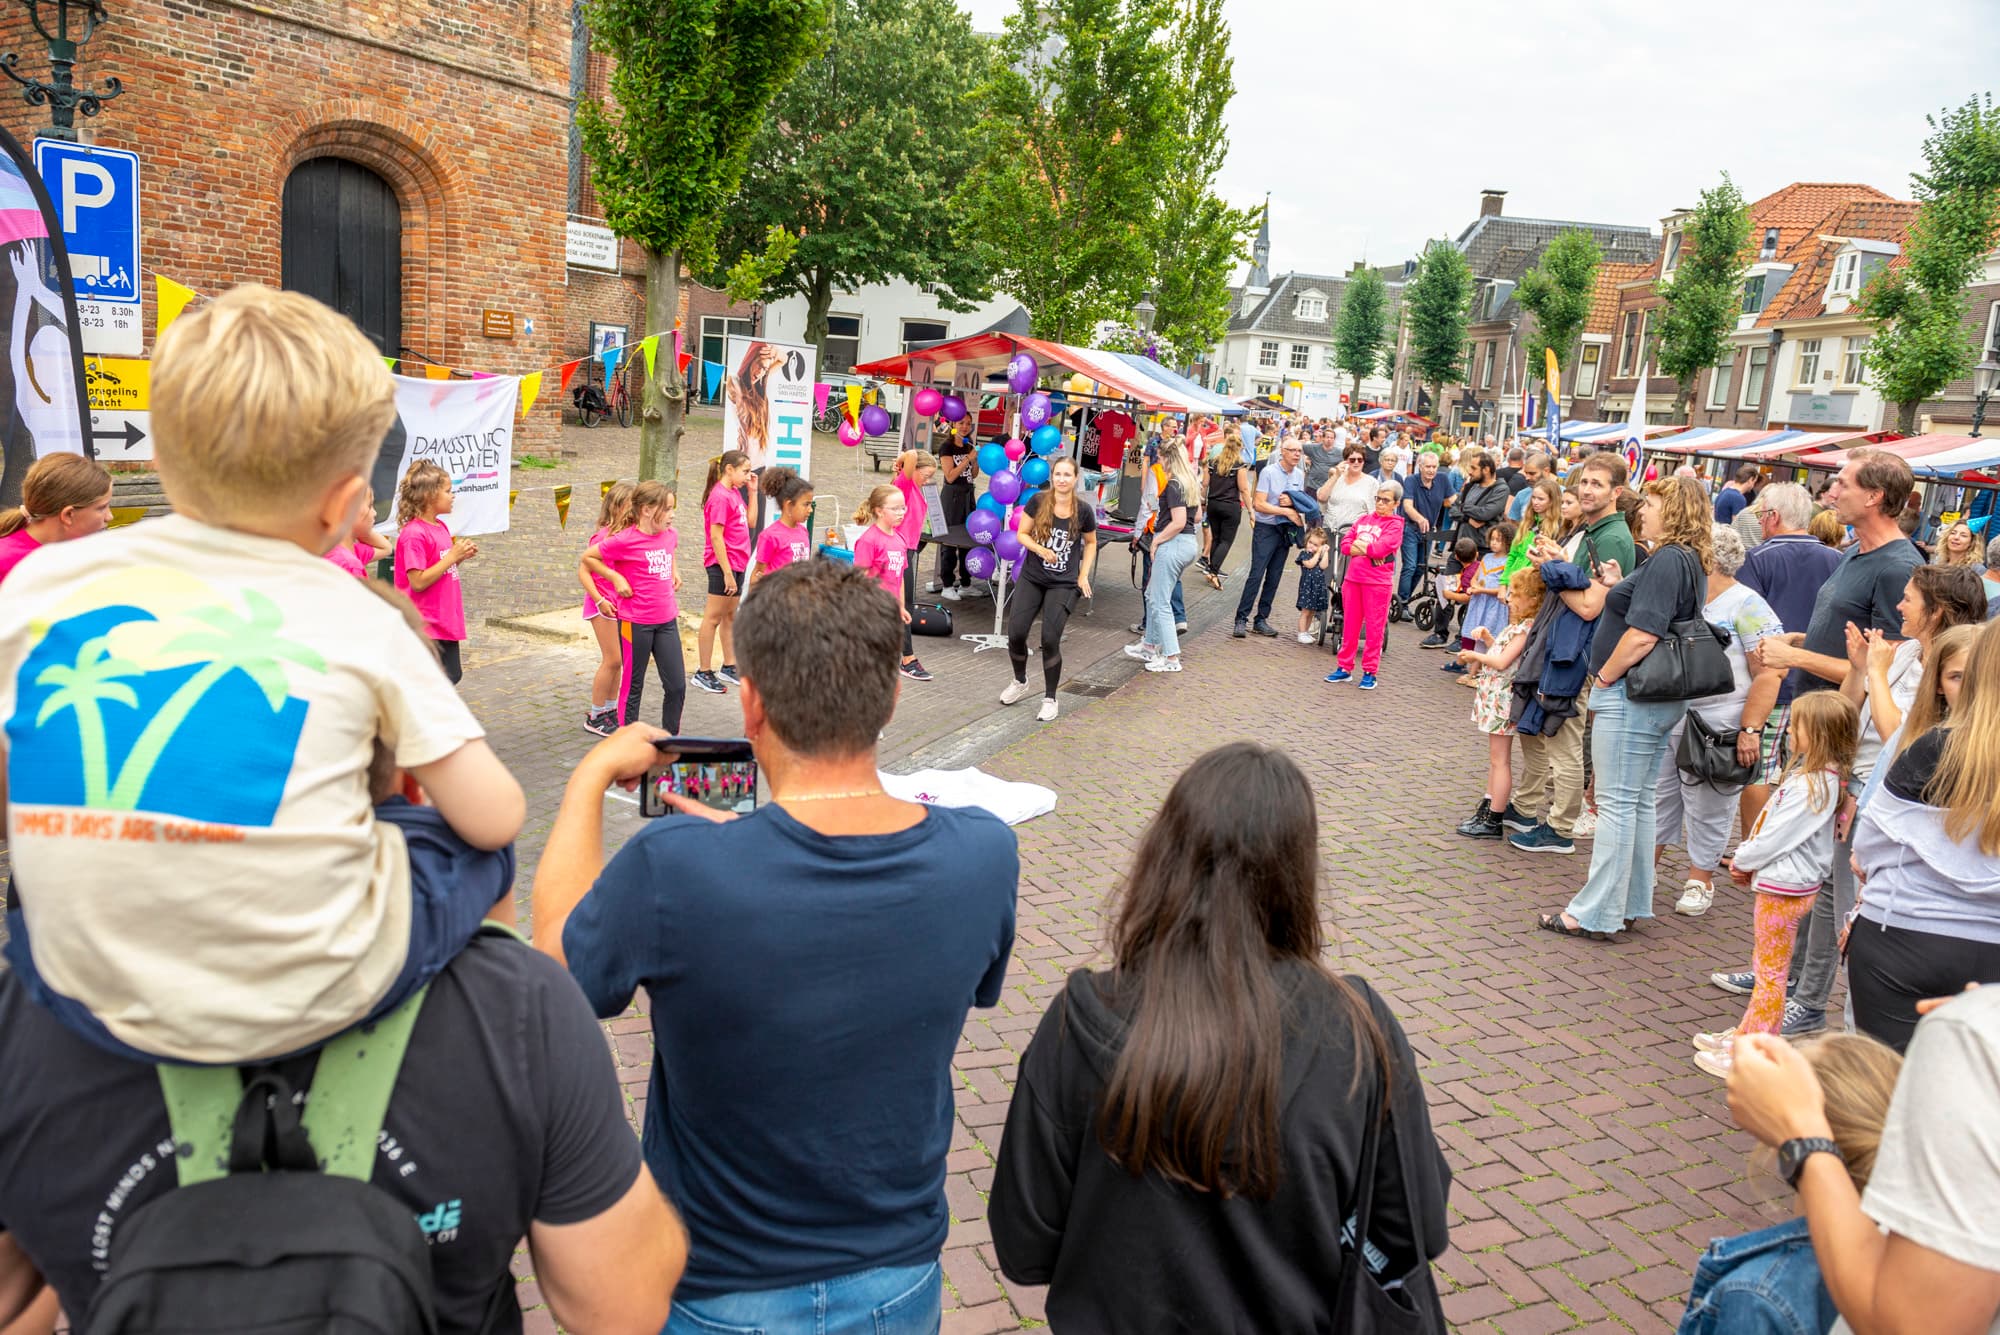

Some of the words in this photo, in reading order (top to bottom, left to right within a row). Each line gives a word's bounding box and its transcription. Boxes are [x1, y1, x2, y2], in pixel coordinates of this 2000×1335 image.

[62, 158, 116, 234] P
[111, 306, 134, 317] 8.30h
[81, 317, 105, 328] -8-'23
[113, 319, 129, 329] 18h
[88, 386, 139, 399] pregeling
[71, 813, 114, 840] DAYS
[118, 818, 157, 843] ARE
